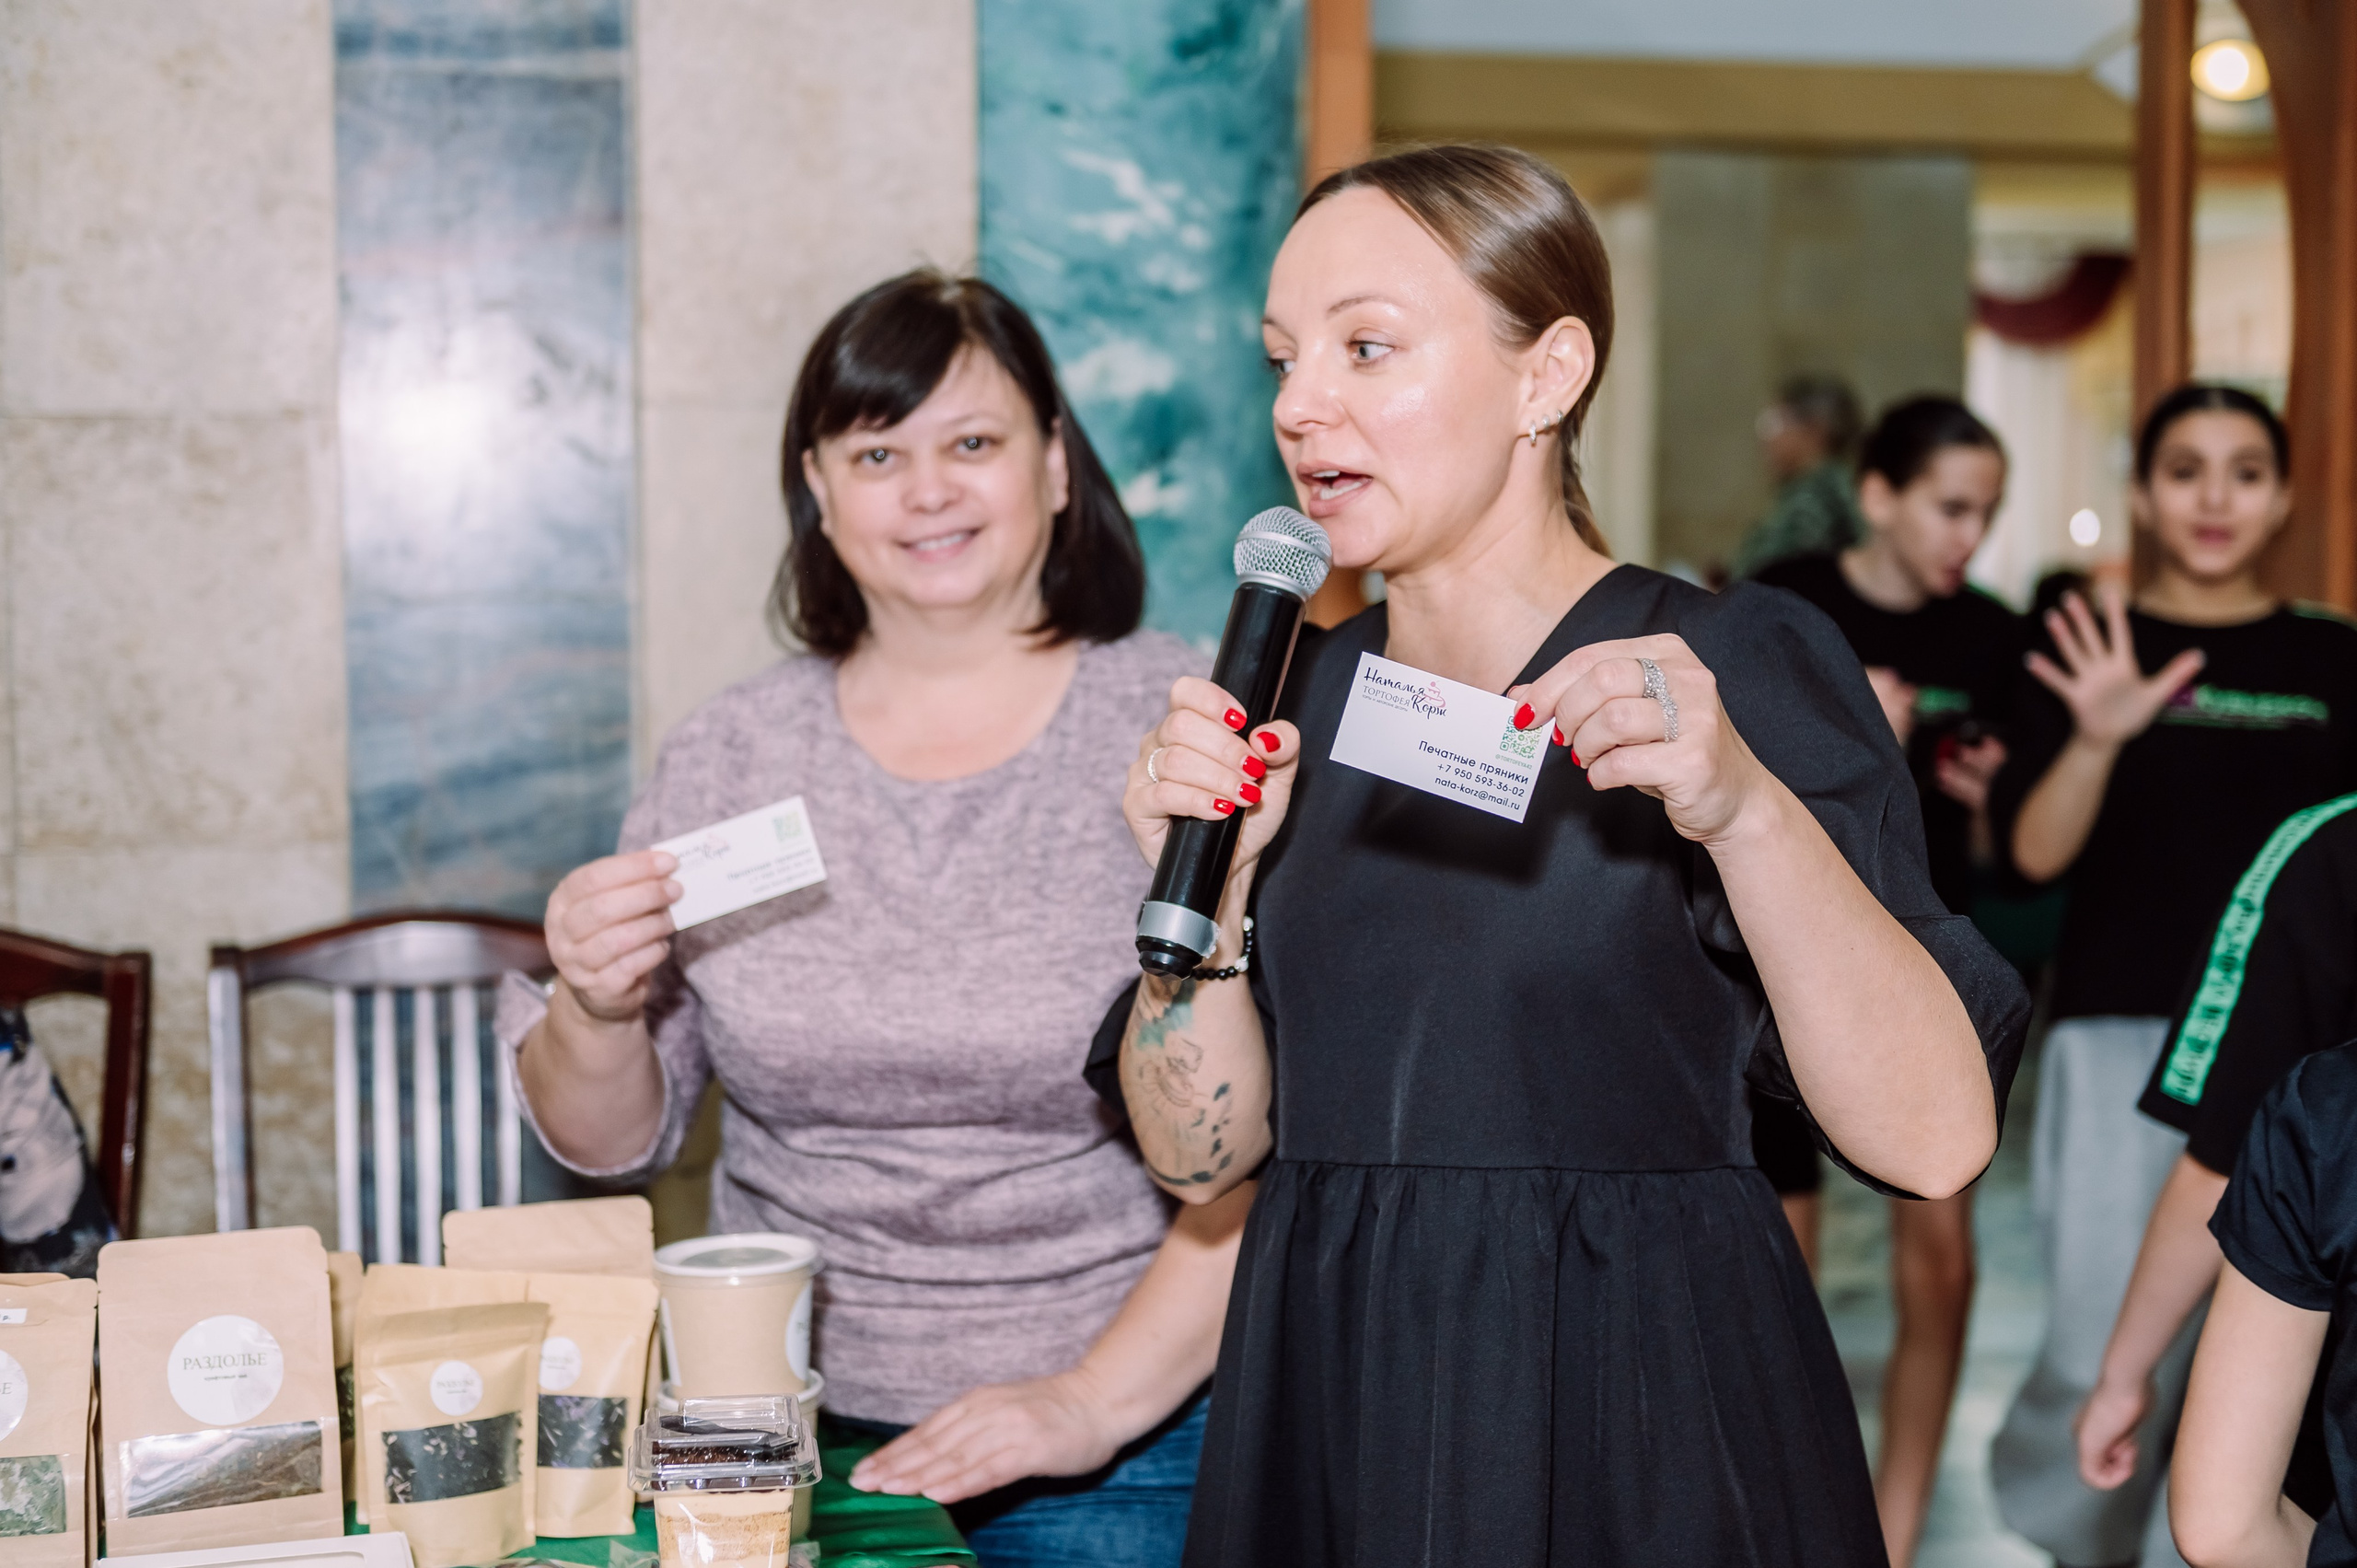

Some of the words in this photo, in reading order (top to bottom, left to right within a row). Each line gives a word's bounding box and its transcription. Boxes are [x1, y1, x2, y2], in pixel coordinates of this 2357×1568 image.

[1363, 685, 1411, 707] ТОРТОФЕЯ
[1364, 667, 1426, 696] Наталья
[1411, 693, 1447, 720] Корж
[1419, 740, 1476, 767] Печатные
[1479, 762, 1529, 784] пряники
[1434, 777, 1521, 810] nata-korz@mail.ru
[1437, 763, 1452, 773] +7
[1454, 768, 1472, 780] 950
[1474, 774, 1525, 797] 593-36-02
[182, 1353, 268, 1371] РАЗДОЛЬЕ
